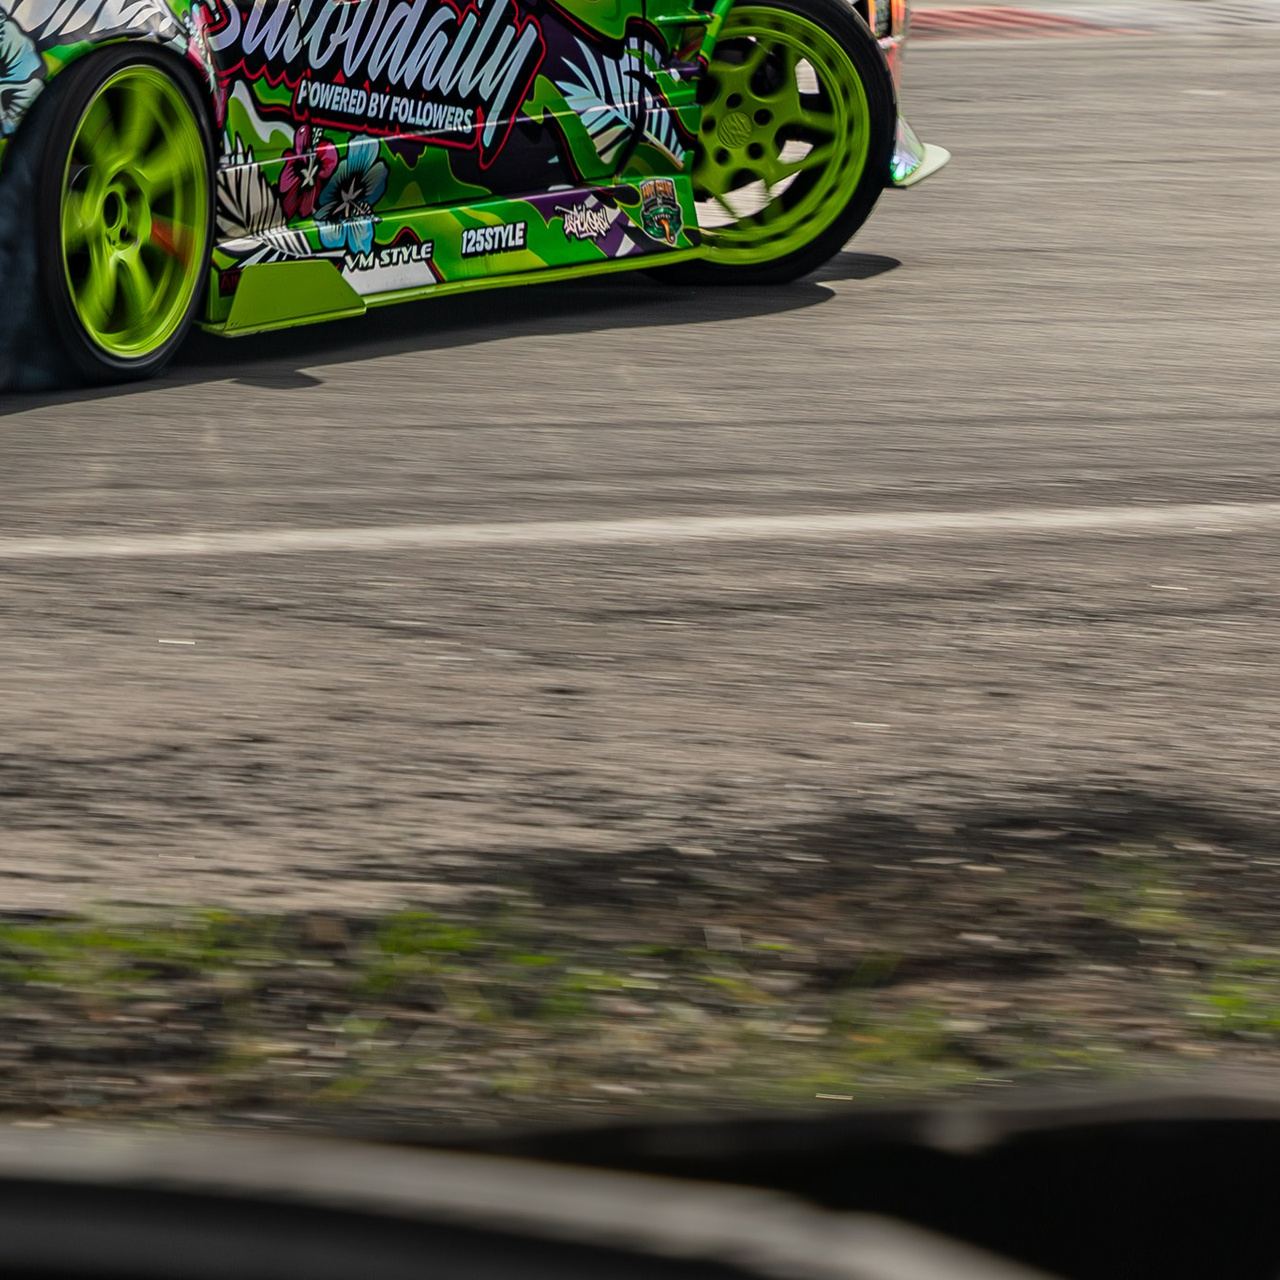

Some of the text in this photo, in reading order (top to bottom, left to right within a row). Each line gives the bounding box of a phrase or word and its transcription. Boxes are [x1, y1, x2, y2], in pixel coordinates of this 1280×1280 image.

[298, 80, 474, 134] POWERED BY FOLLOWERS
[380, 242, 433, 266] STYLE
